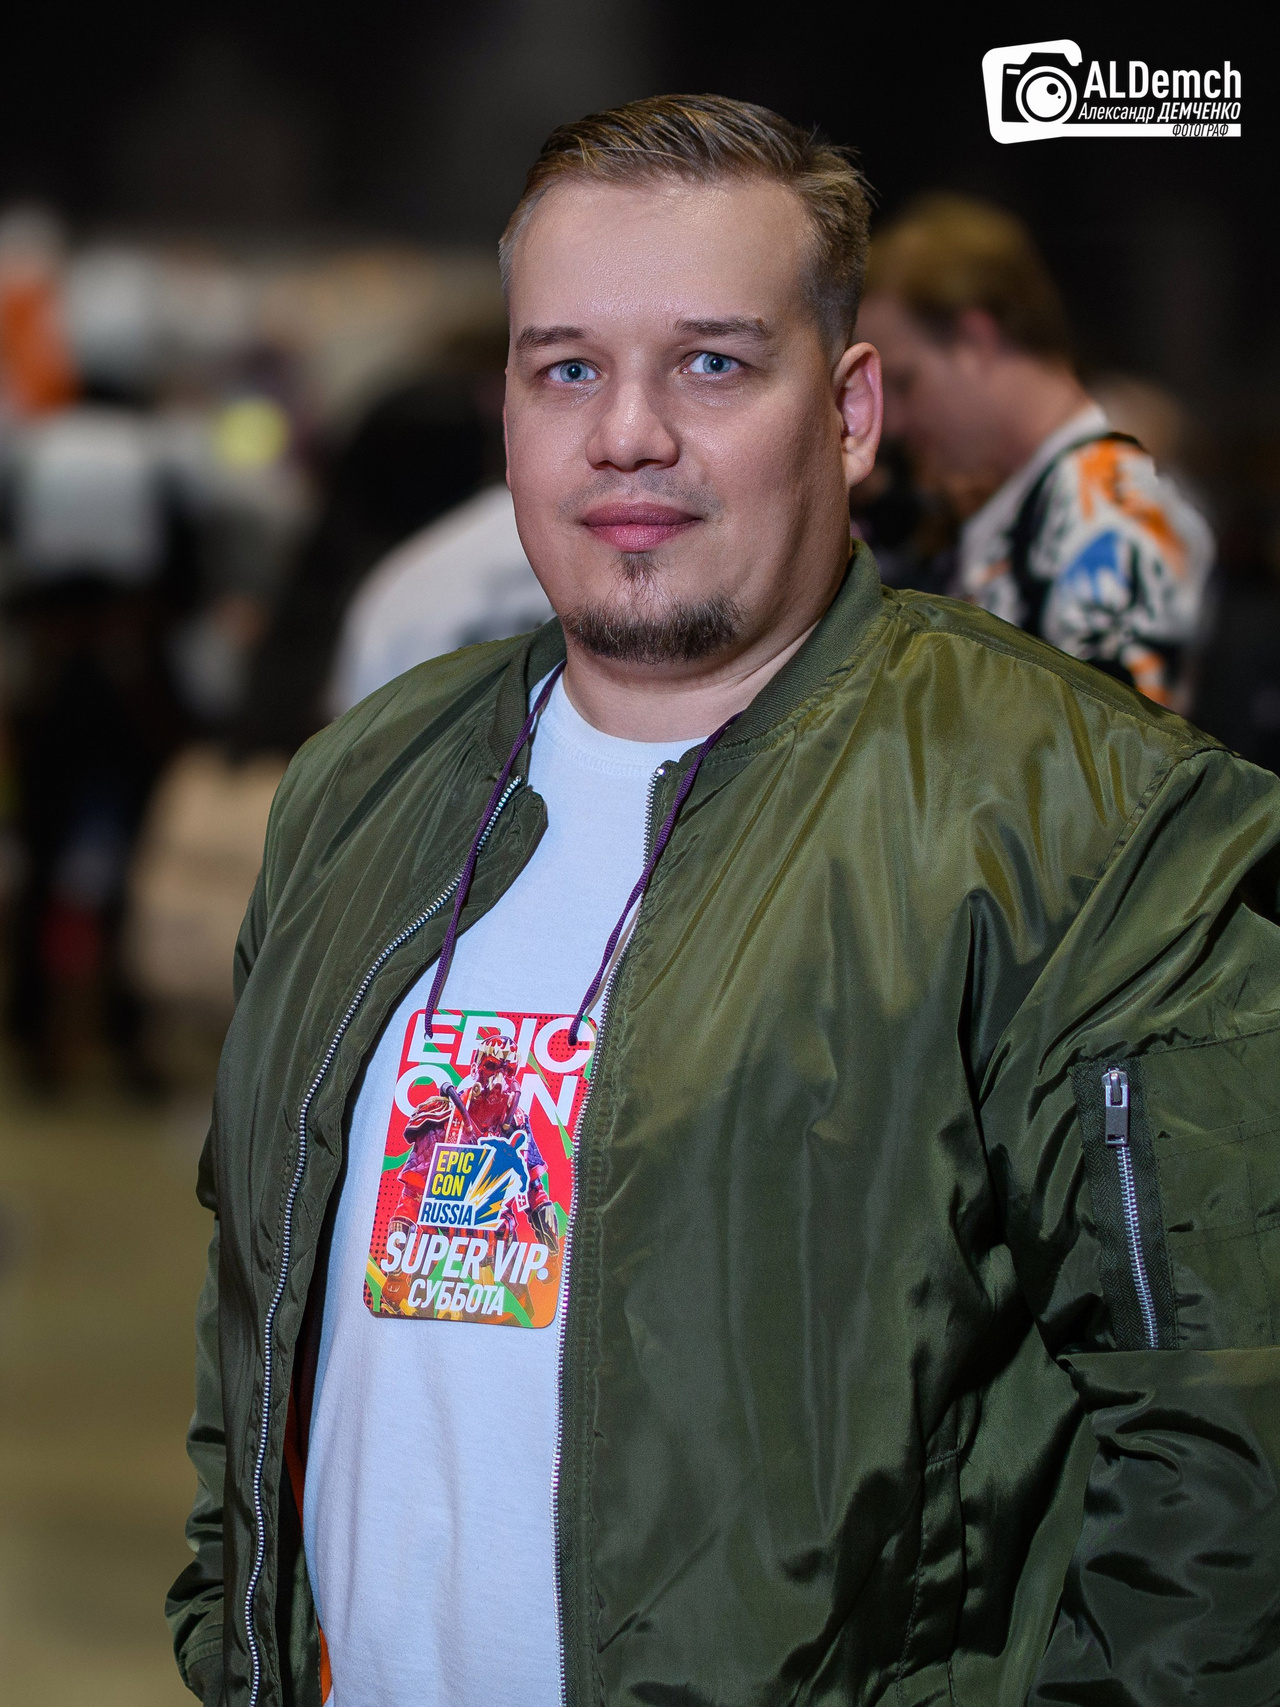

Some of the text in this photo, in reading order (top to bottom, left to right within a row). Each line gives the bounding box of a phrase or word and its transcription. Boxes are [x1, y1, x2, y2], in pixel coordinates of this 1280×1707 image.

[407, 1014, 595, 1073] EPIC
[395, 1064, 578, 1126] CN
[436, 1150, 475, 1174] EPIC
[431, 1173, 465, 1197] CON
[420, 1201, 474, 1226] RUSSIA
[380, 1231, 488, 1280] SUPER
[407, 1278, 505, 1316] СУББОТА
